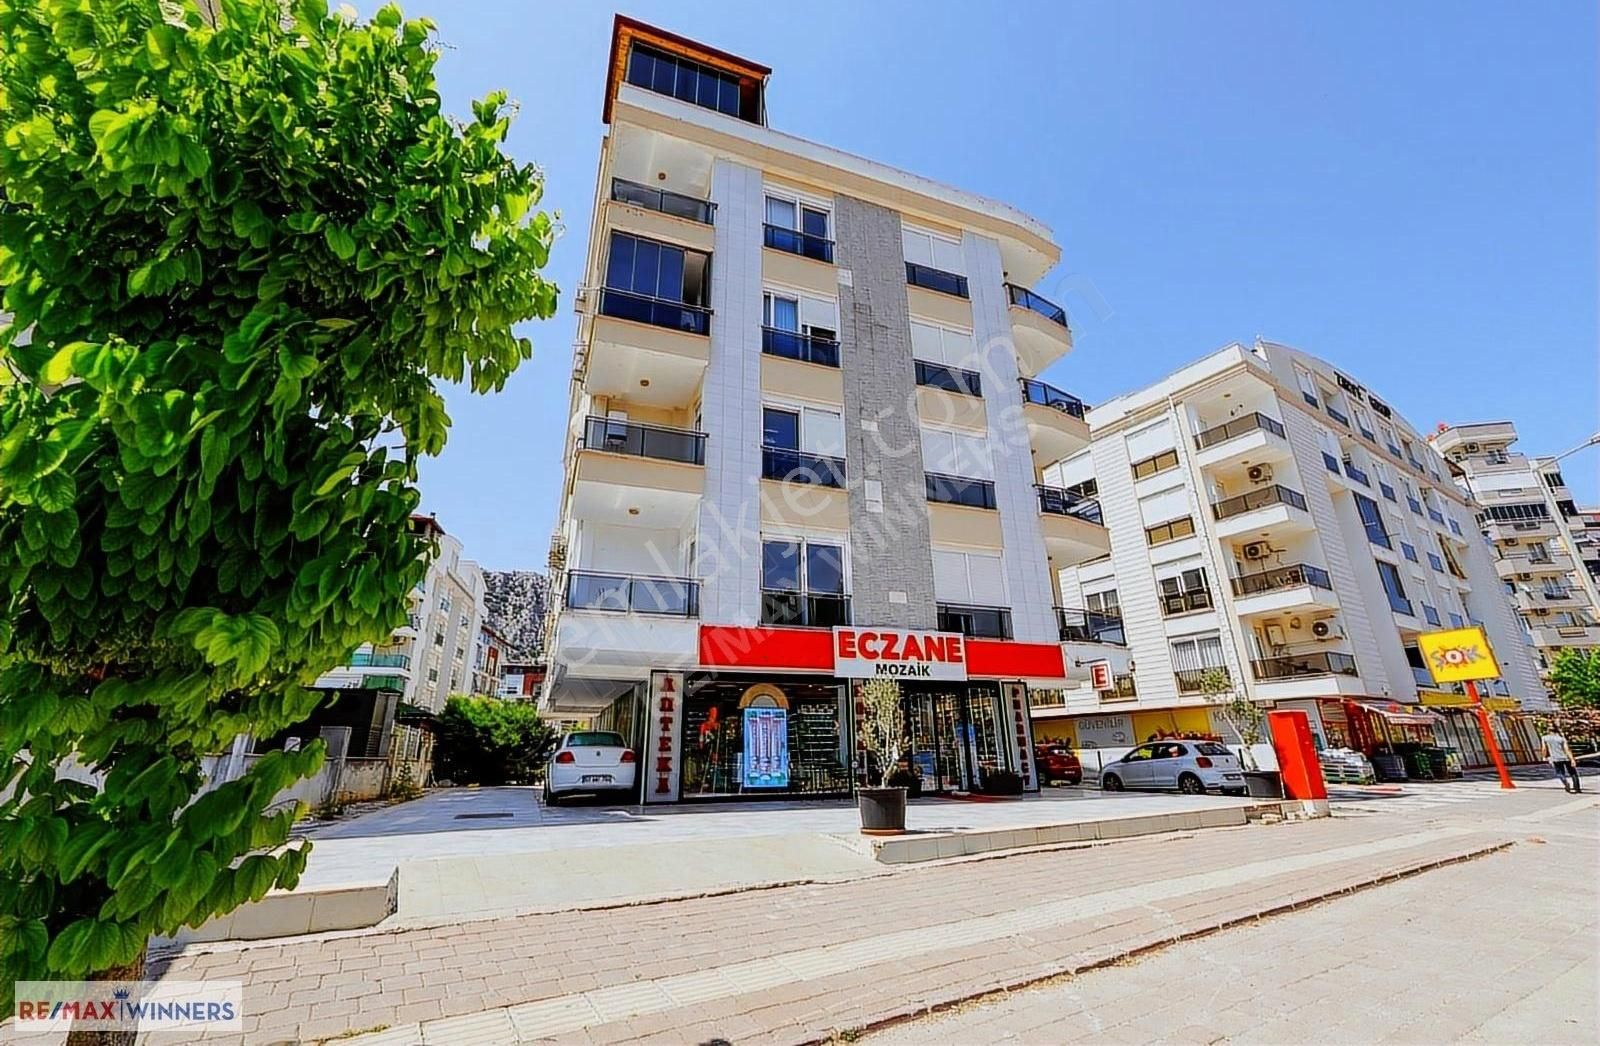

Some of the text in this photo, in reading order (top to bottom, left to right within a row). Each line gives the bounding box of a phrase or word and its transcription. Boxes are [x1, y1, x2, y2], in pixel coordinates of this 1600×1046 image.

[838, 631, 963, 662] ECZANE
[875, 662, 930, 676] MOZAİK
[1094, 668, 1107, 685] E
